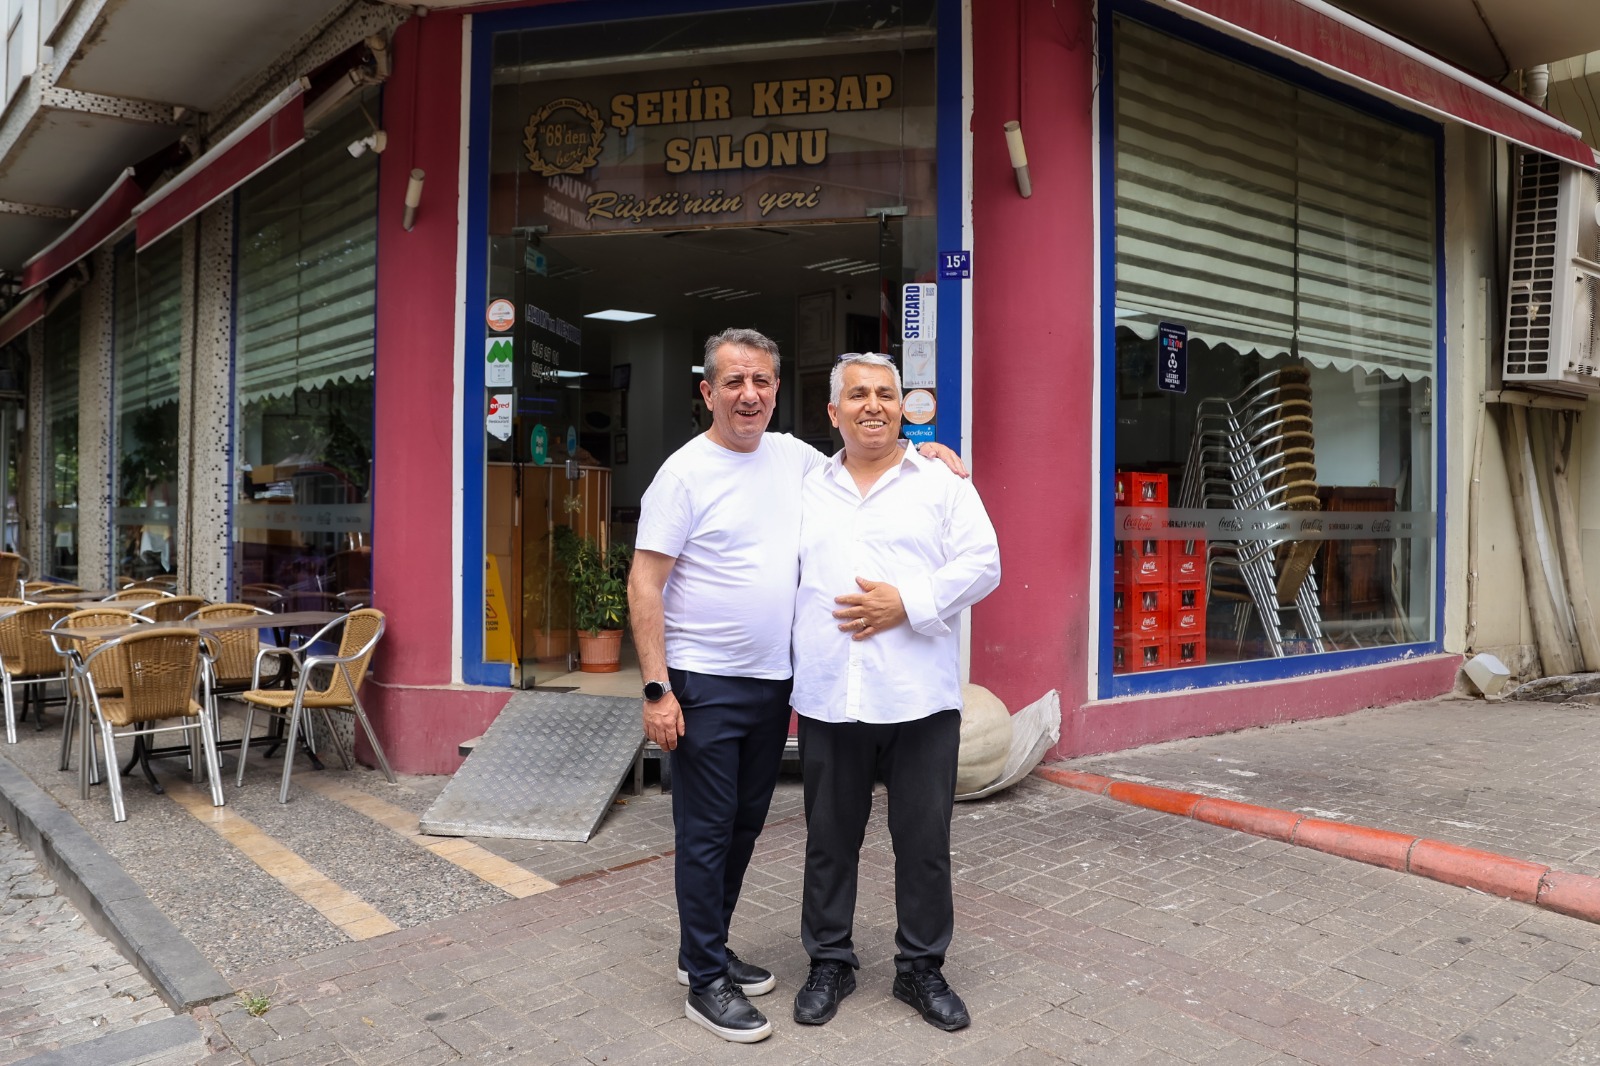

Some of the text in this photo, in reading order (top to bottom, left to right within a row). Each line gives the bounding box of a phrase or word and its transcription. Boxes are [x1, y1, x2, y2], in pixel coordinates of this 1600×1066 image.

[610, 74, 893, 136] ŞEHİR KEBAP
[665, 129, 830, 173] SALONU
[758, 185, 822, 217] yeri
[904, 285, 920, 339] SETCARD
[905, 428, 933, 437] sodexo
